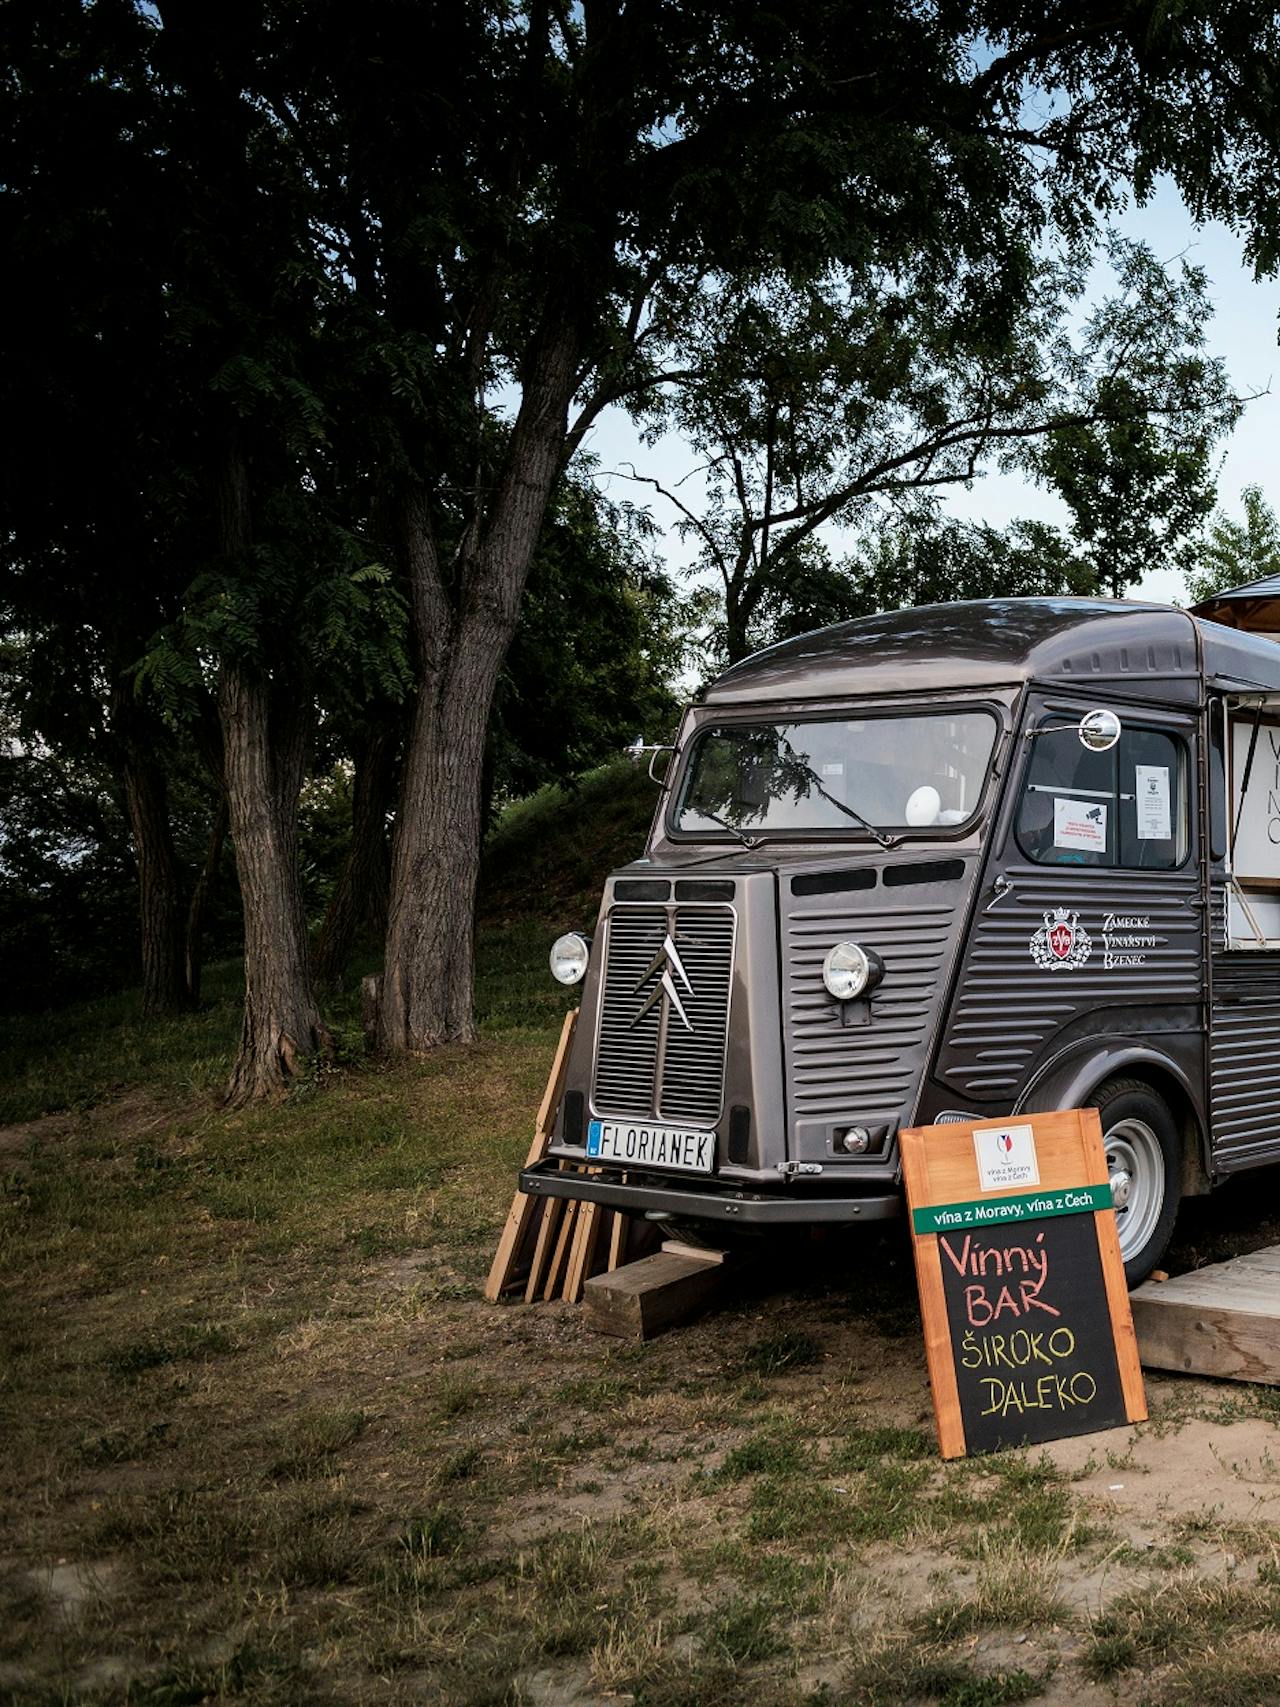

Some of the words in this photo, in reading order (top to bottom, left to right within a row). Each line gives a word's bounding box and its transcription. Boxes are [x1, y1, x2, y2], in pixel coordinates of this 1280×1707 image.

[601, 1126, 708, 1167] FLORIANEK
[934, 1211, 963, 1225] vína
[965, 1212, 973, 1222] z
[975, 1204, 1024, 1220] Moravy,
[1027, 1199, 1054, 1213] vína
[1055, 1199, 1064, 1209] z
[1064, 1192, 1094, 1208] Čech
[964, 1279, 1062, 1327] BAR
[962, 1327, 1075, 1369] ŠIROKO
[979, 1371, 1097, 1417] DALEKO
